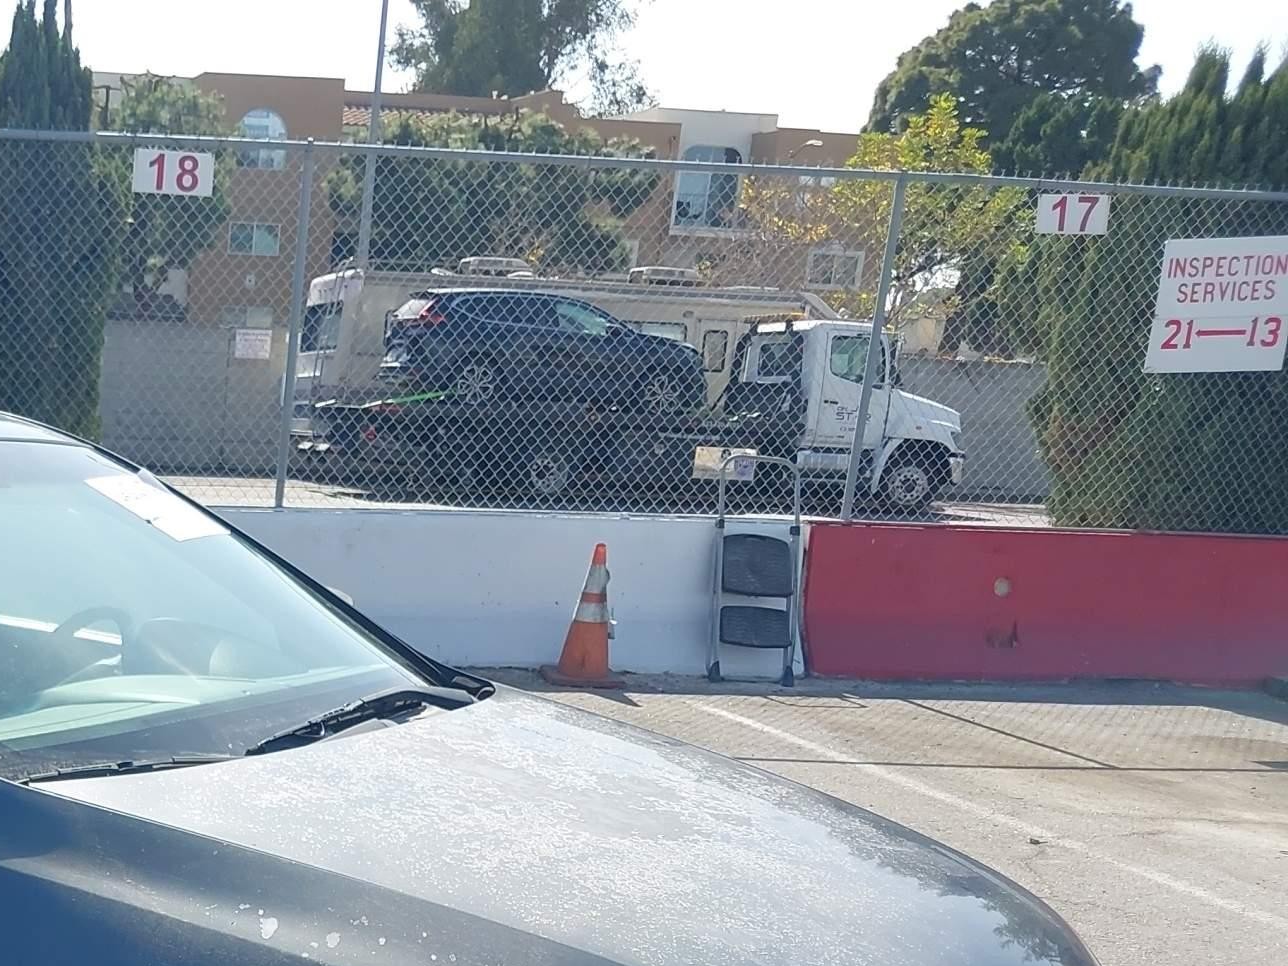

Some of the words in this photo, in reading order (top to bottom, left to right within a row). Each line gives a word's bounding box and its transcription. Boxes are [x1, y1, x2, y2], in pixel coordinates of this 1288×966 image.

[149, 153, 200, 192] 18
[1052, 196, 1100, 232] 17
[1167, 255, 1288, 279] INSPECTION
[1176, 280, 1276, 304] SERVICES
[1160, 319, 1194, 350] 21
[1246, 316, 1282, 348] 13
